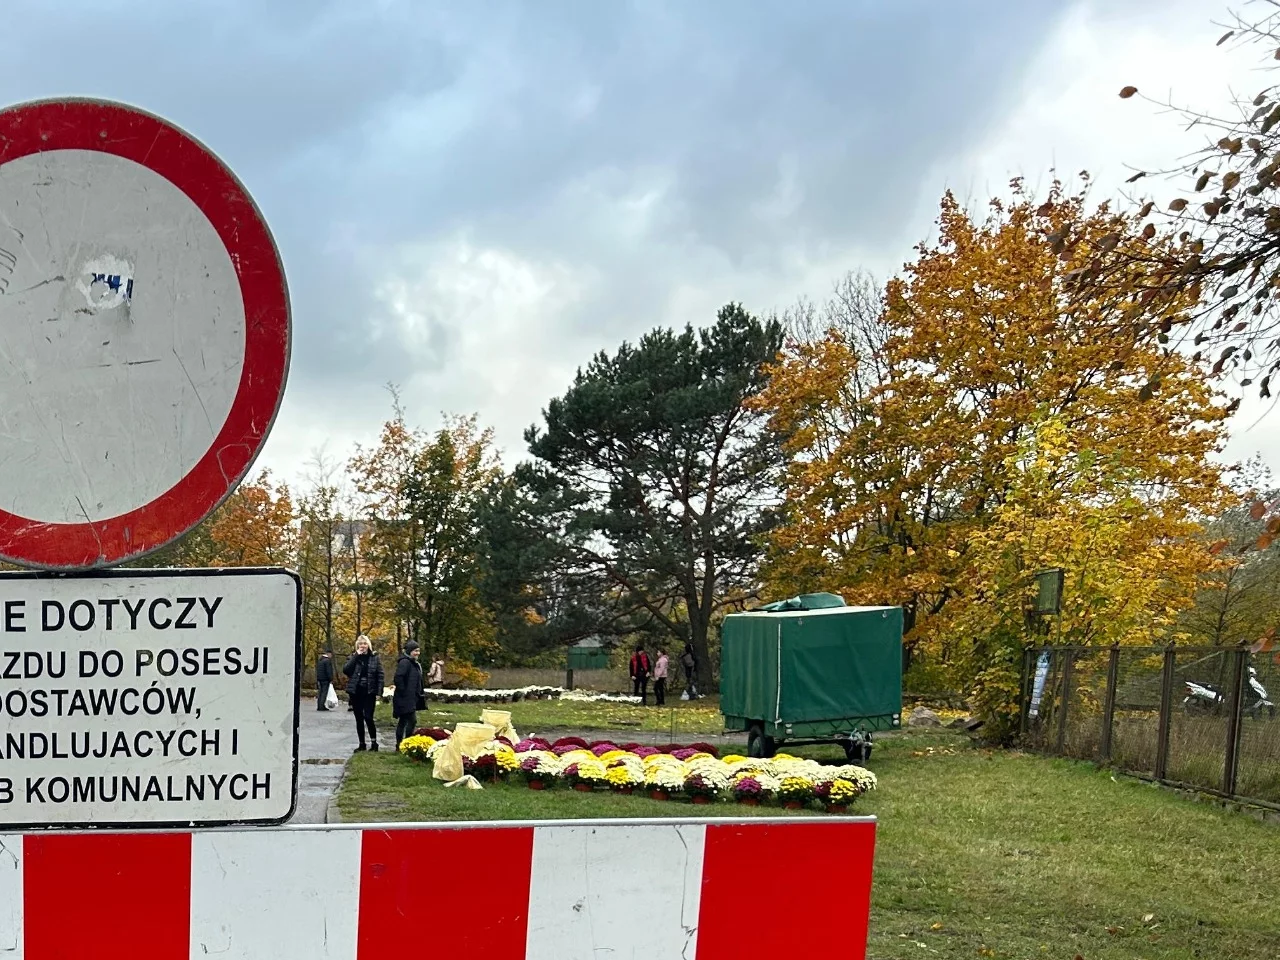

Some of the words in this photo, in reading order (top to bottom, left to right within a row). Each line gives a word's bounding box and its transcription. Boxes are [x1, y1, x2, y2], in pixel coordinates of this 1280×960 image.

[41, 596, 224, 632] DOTYCZY
[78, 649, 124, 678] DO
[135, 646, 269, 677] POSESJI
[231, 728, 238, 756] I
[25, 772, 271, 804] KOMUNALNYCH
